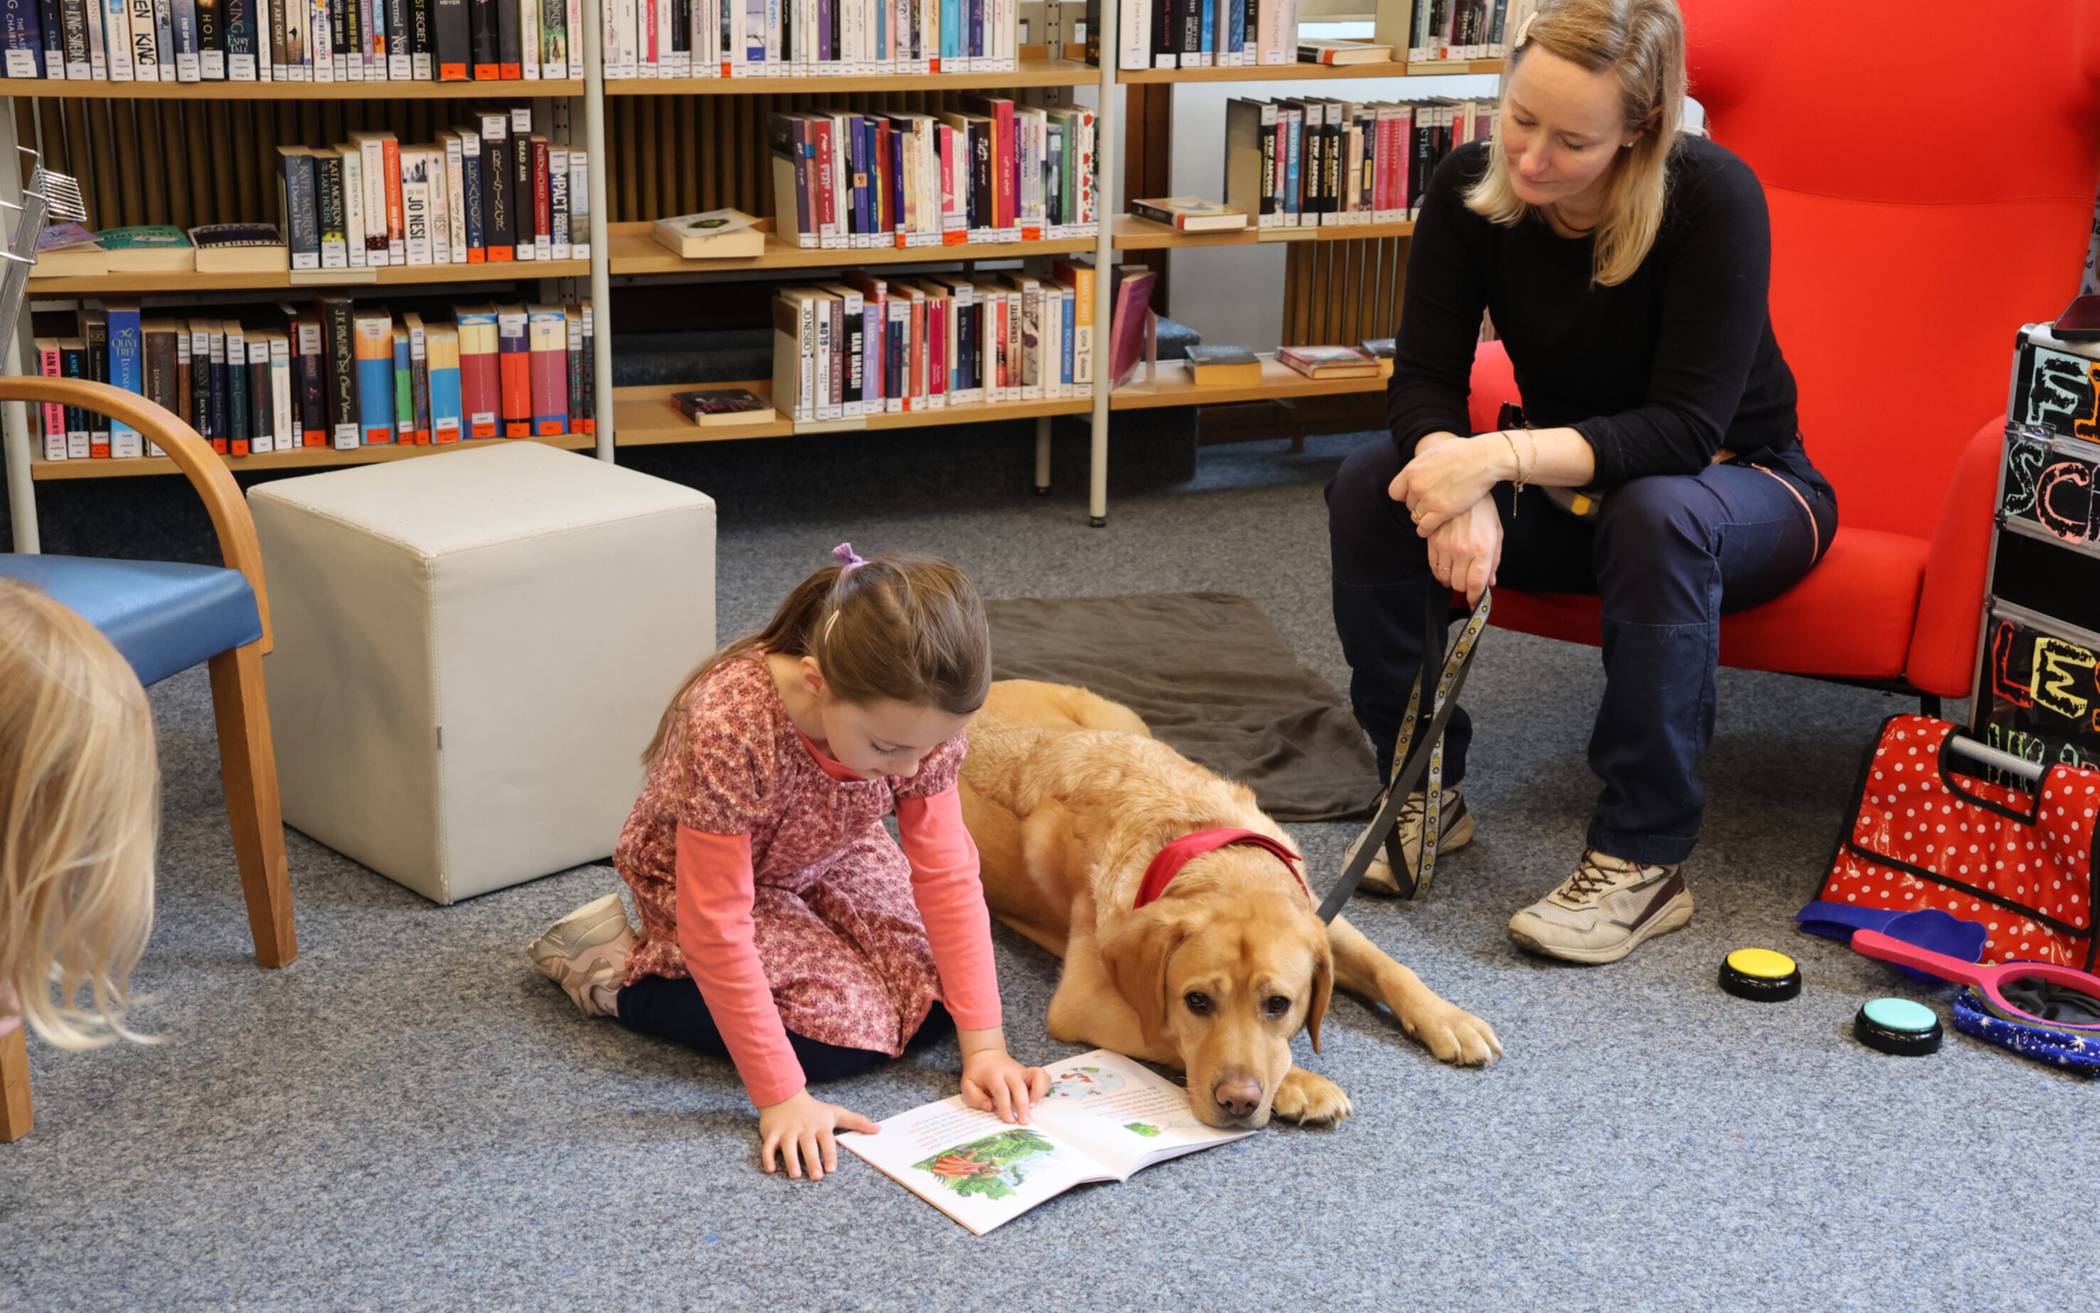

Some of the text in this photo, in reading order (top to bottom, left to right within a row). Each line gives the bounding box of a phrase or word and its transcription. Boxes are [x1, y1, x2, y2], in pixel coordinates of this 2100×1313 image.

[6, 13, 17, 50] CHAIRLIF
[65, 10, 82, 31] KING
[202, 13, 213, 51] HOLL
[274, 8, 282, 21] ARE
[135, 33, 156, 65] KING
[227, 34, 249, 46] FAIRY
[275, 24, 283, 46] OKAY
[518, 140, 527, 182] DEAD AIM
[1266, 159, 1274, 197] ЛАРССОН
[1311, 159, 1319, 197] ЛАРССОН
[1331, 159, 1339, 197] ЛАРССОН
[321, 173, 330, 194] LAKE
[328, 160, 342, 226] KATE MORTON
[467, 160, 481, 229] ERAGON
[491, 149, 506, 233] BRISINGR
[552, 171, 567, 212] MPACT
[302, 197, 314, 246] MORTON
[322, 195, 332, 224] HOUSE
[408, 196, 426, 240] JO NES
[803, 307, 813, 320] JO
[46, 352, 58, 366] IAN
[335, 325, 349, 358] ROWLING
[70, 353, 78, 374] ANNE
[120, 358, 131, 391] LUCIND
[850, 332, 863, 389] KAN HASADI
